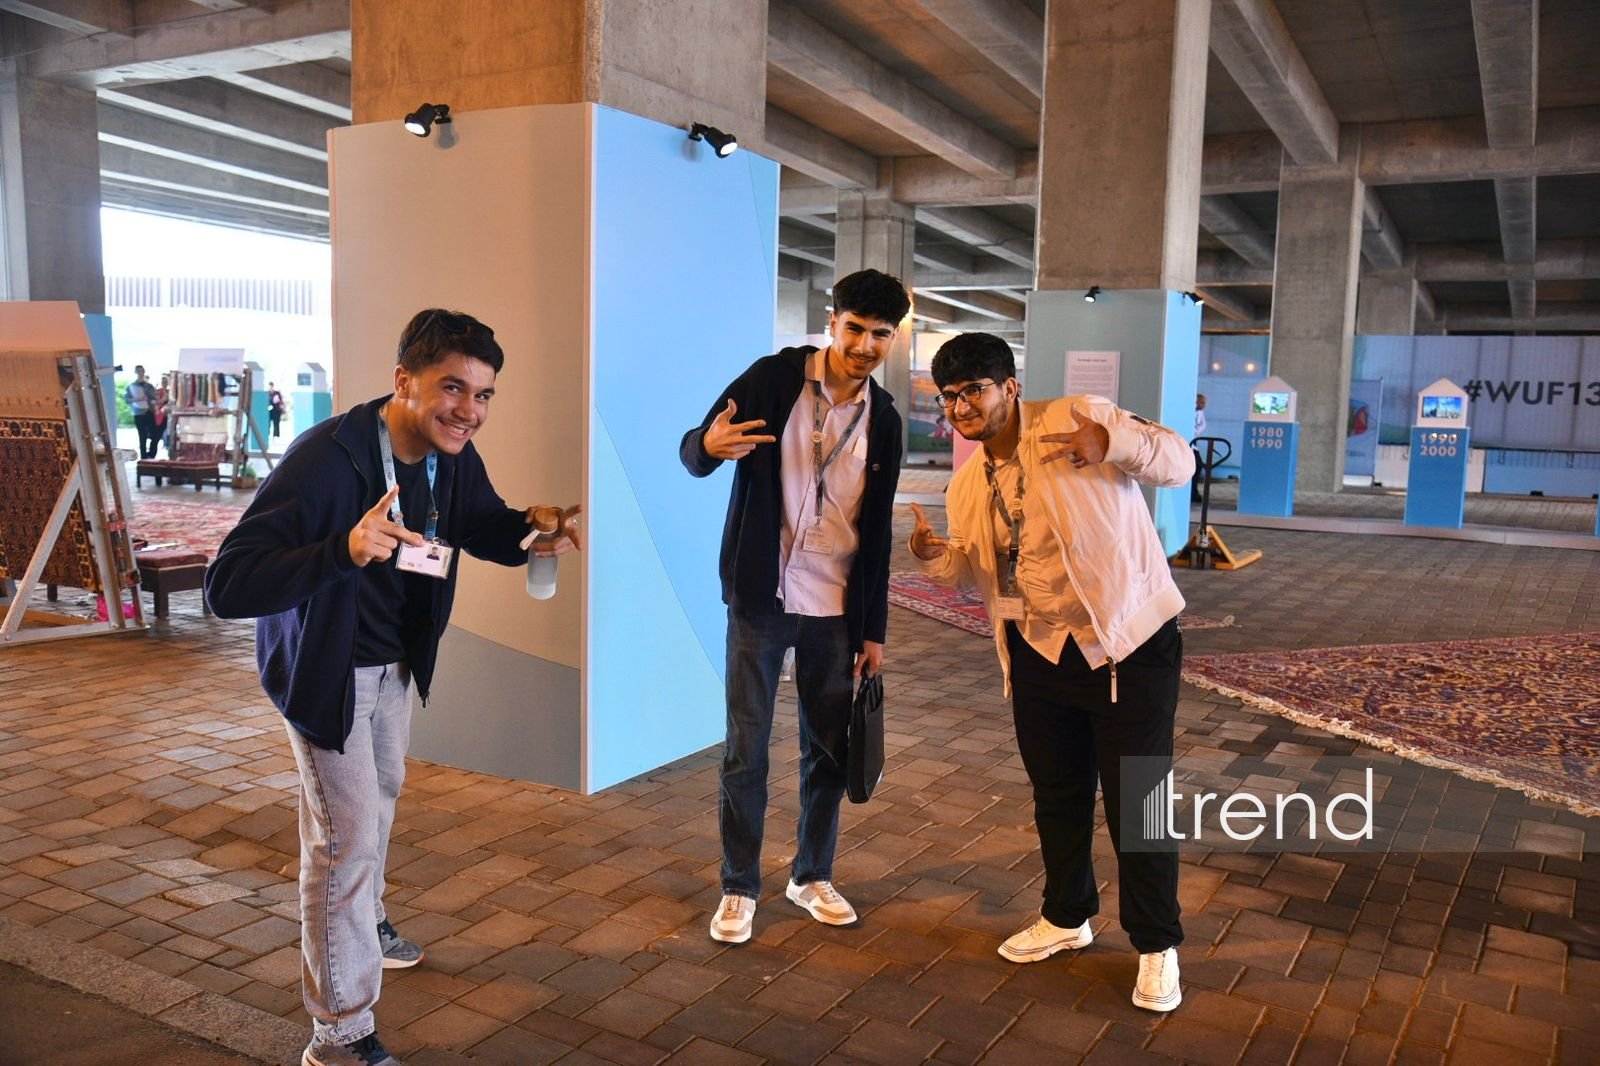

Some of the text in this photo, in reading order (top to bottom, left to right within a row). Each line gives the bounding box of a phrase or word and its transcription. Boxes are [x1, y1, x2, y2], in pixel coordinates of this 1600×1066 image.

[1463, 379, 1600, 406] #WUF13
[1251, 427, 1284, 438] 1980
[1421, 432, 1457, 444] 1990
[1251, 439, 1283, 449] 1990
[1420, 445, 1457, 456] 2000
